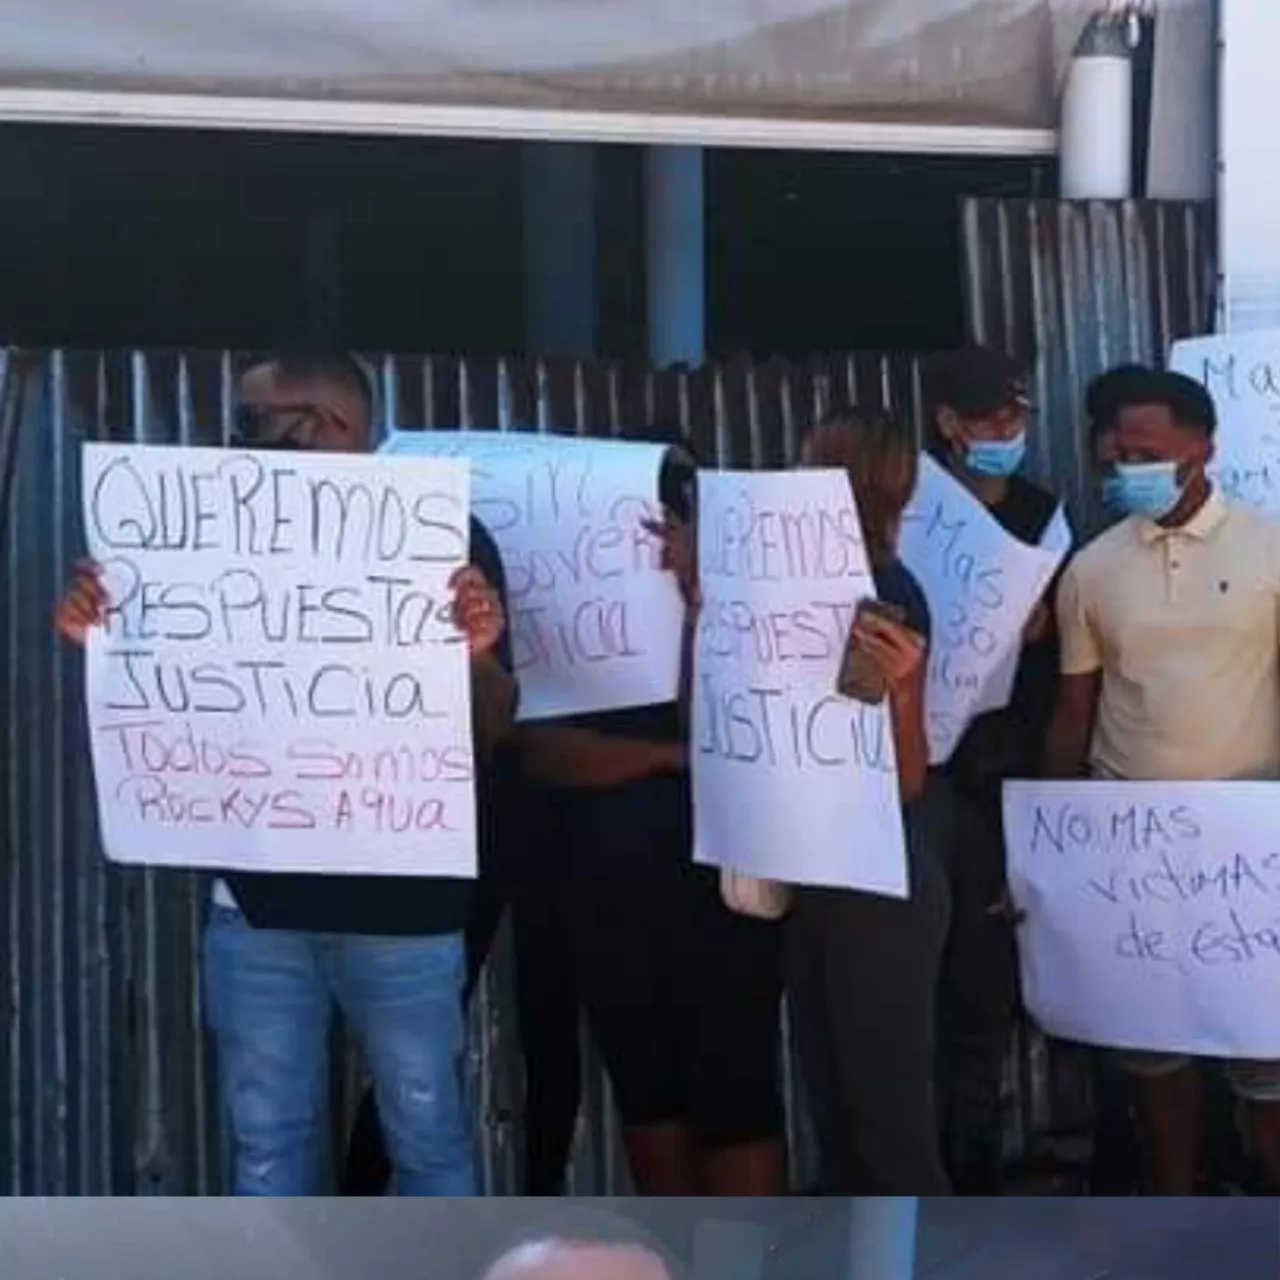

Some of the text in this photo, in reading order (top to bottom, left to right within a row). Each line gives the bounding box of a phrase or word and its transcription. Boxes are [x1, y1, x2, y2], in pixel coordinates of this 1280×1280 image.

[1031, 803, 1201, 854] NO MAS
[1115, 910, 1177, 962] de
